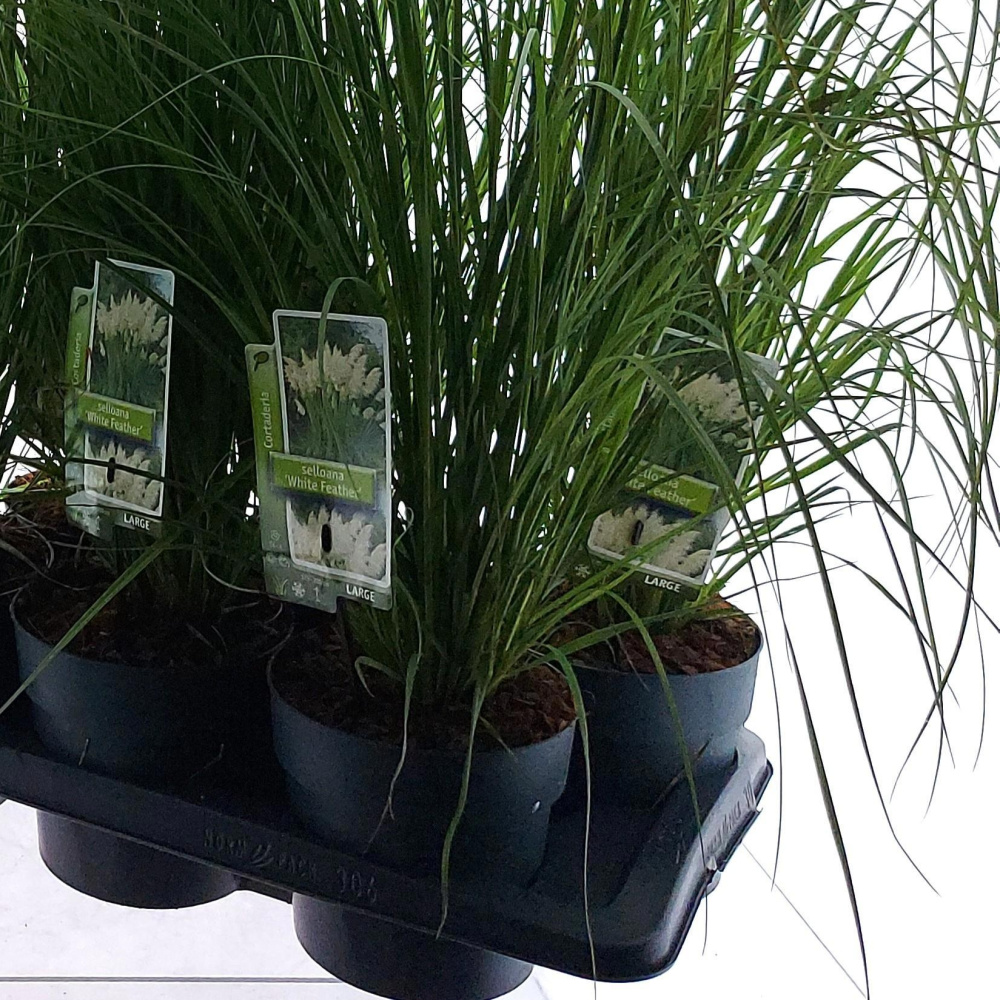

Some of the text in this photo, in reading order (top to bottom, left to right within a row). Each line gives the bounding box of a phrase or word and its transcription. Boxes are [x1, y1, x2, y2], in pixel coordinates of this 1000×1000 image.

[260, 391, 274, 449] Cortaderia
[301, 464, 345, 481] selloana
[123, 512, 151, 531] LARGE
[345, 583, 376, 603] LARGE
[644, 574, 682, 593] LARGE
